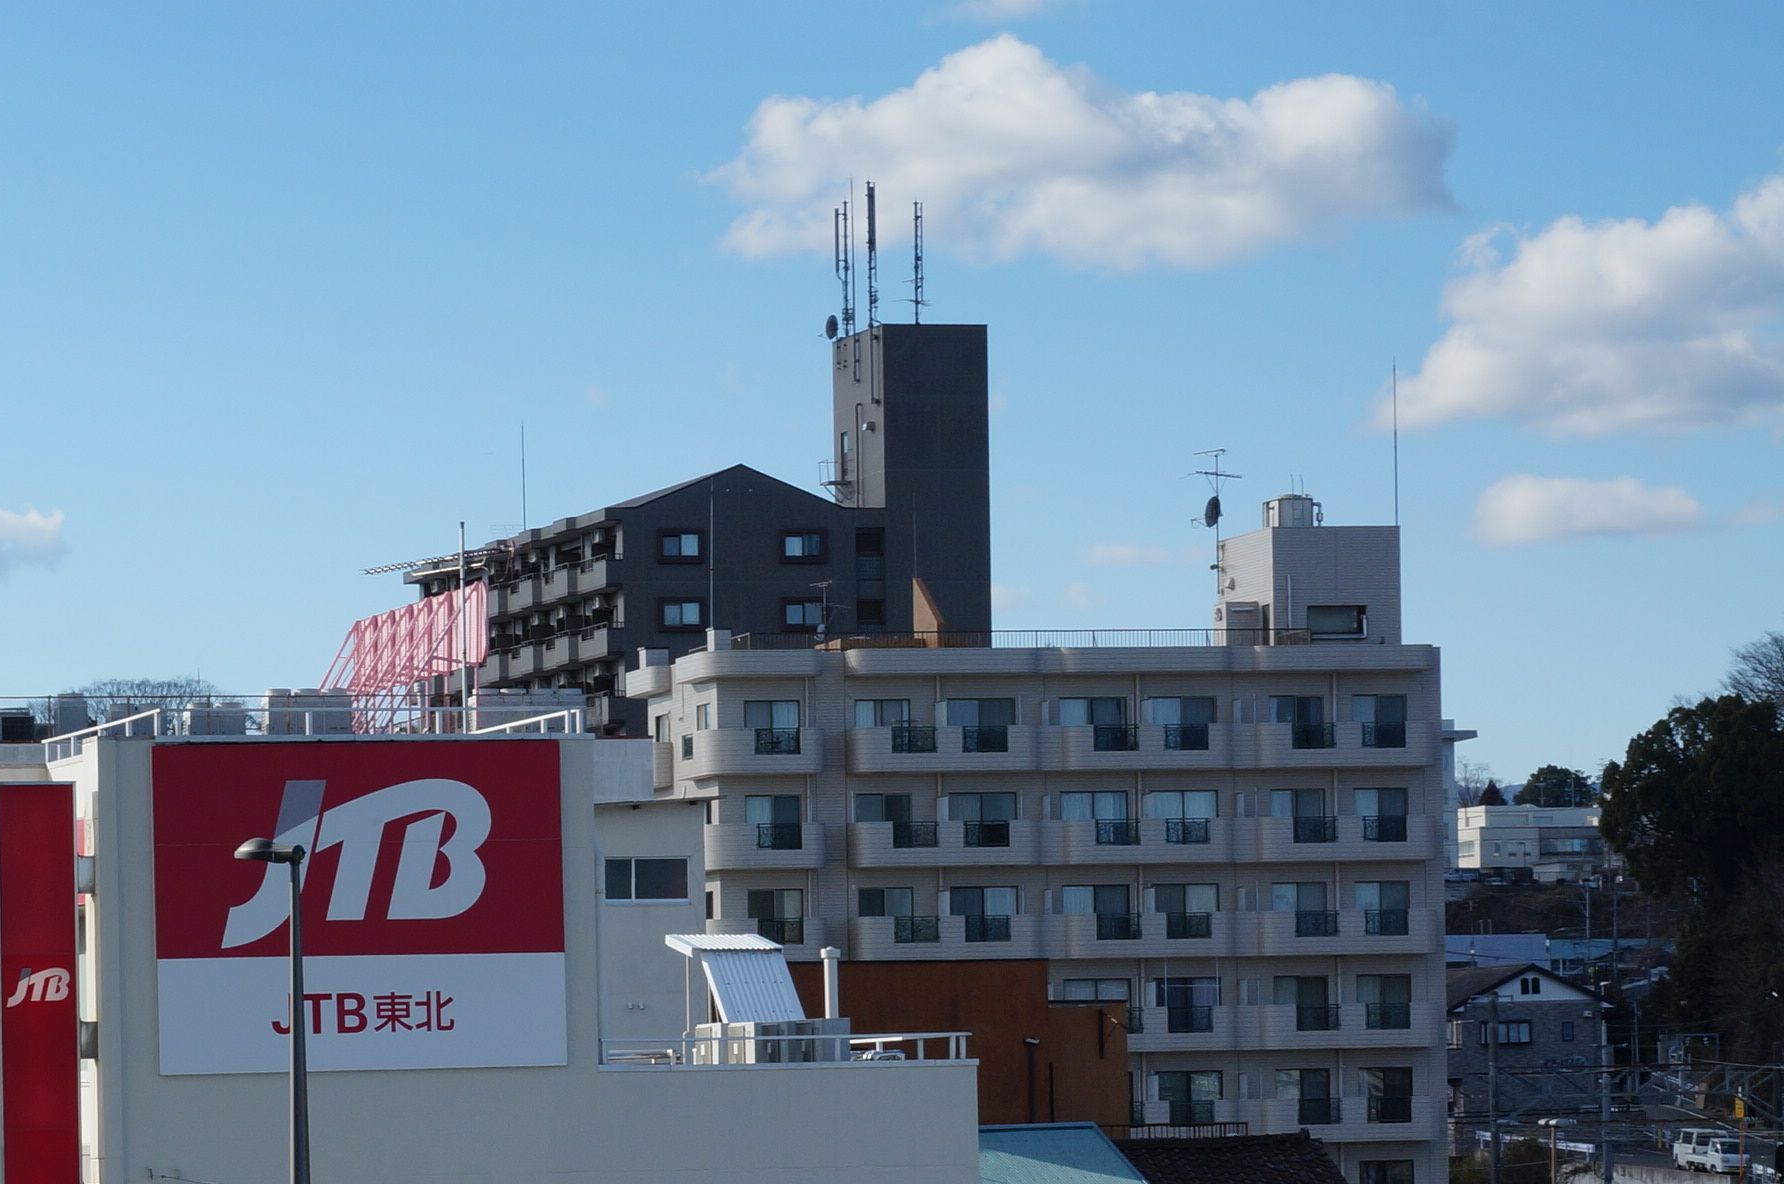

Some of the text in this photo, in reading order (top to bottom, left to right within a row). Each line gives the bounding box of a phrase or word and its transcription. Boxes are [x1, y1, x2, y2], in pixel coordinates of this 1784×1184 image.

[221, 779, 492, 949] JTB
[6, 967, 70, 1008] JTB
[271, 991, 455, 1035] JTB東北
